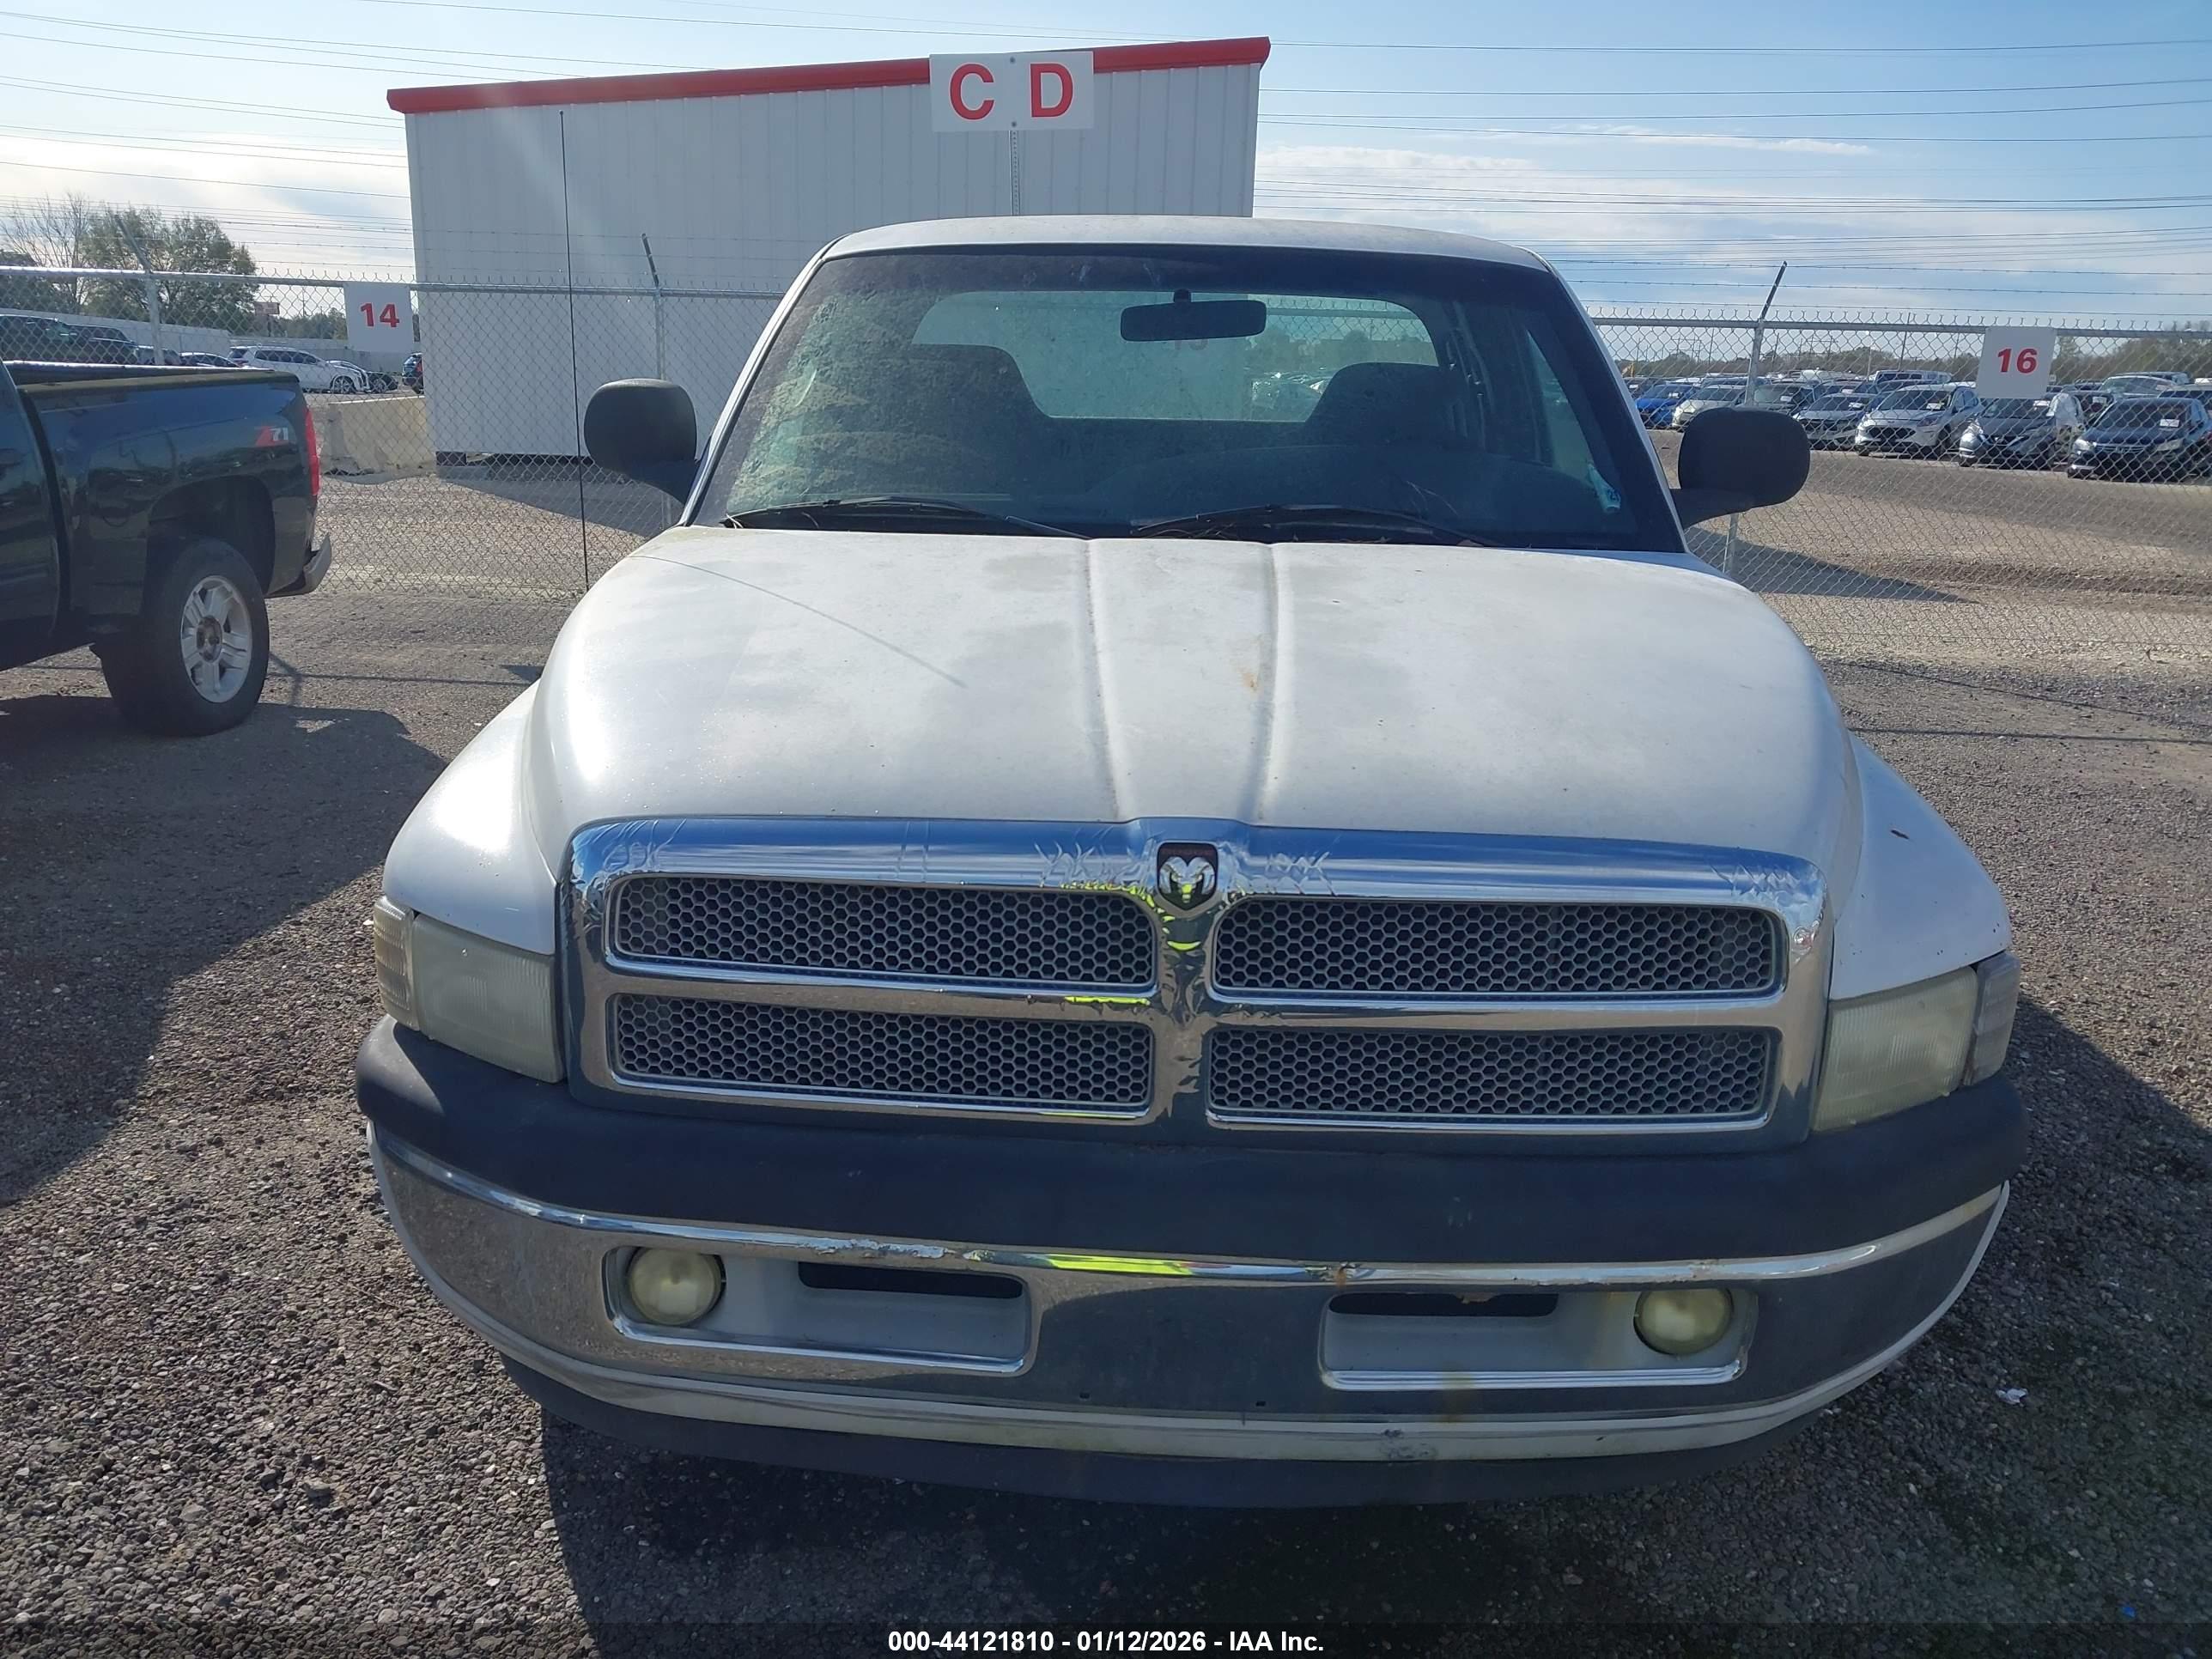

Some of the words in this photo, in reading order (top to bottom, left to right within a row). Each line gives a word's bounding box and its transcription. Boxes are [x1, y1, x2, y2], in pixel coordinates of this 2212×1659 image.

[950, 63, 994, 120] C
[1030, 63, 1073, 118] D
[361, 303, 400, 328] 14
[1997, 348, 2038, 374] 16
[254, 426, 289, 447] Z71
